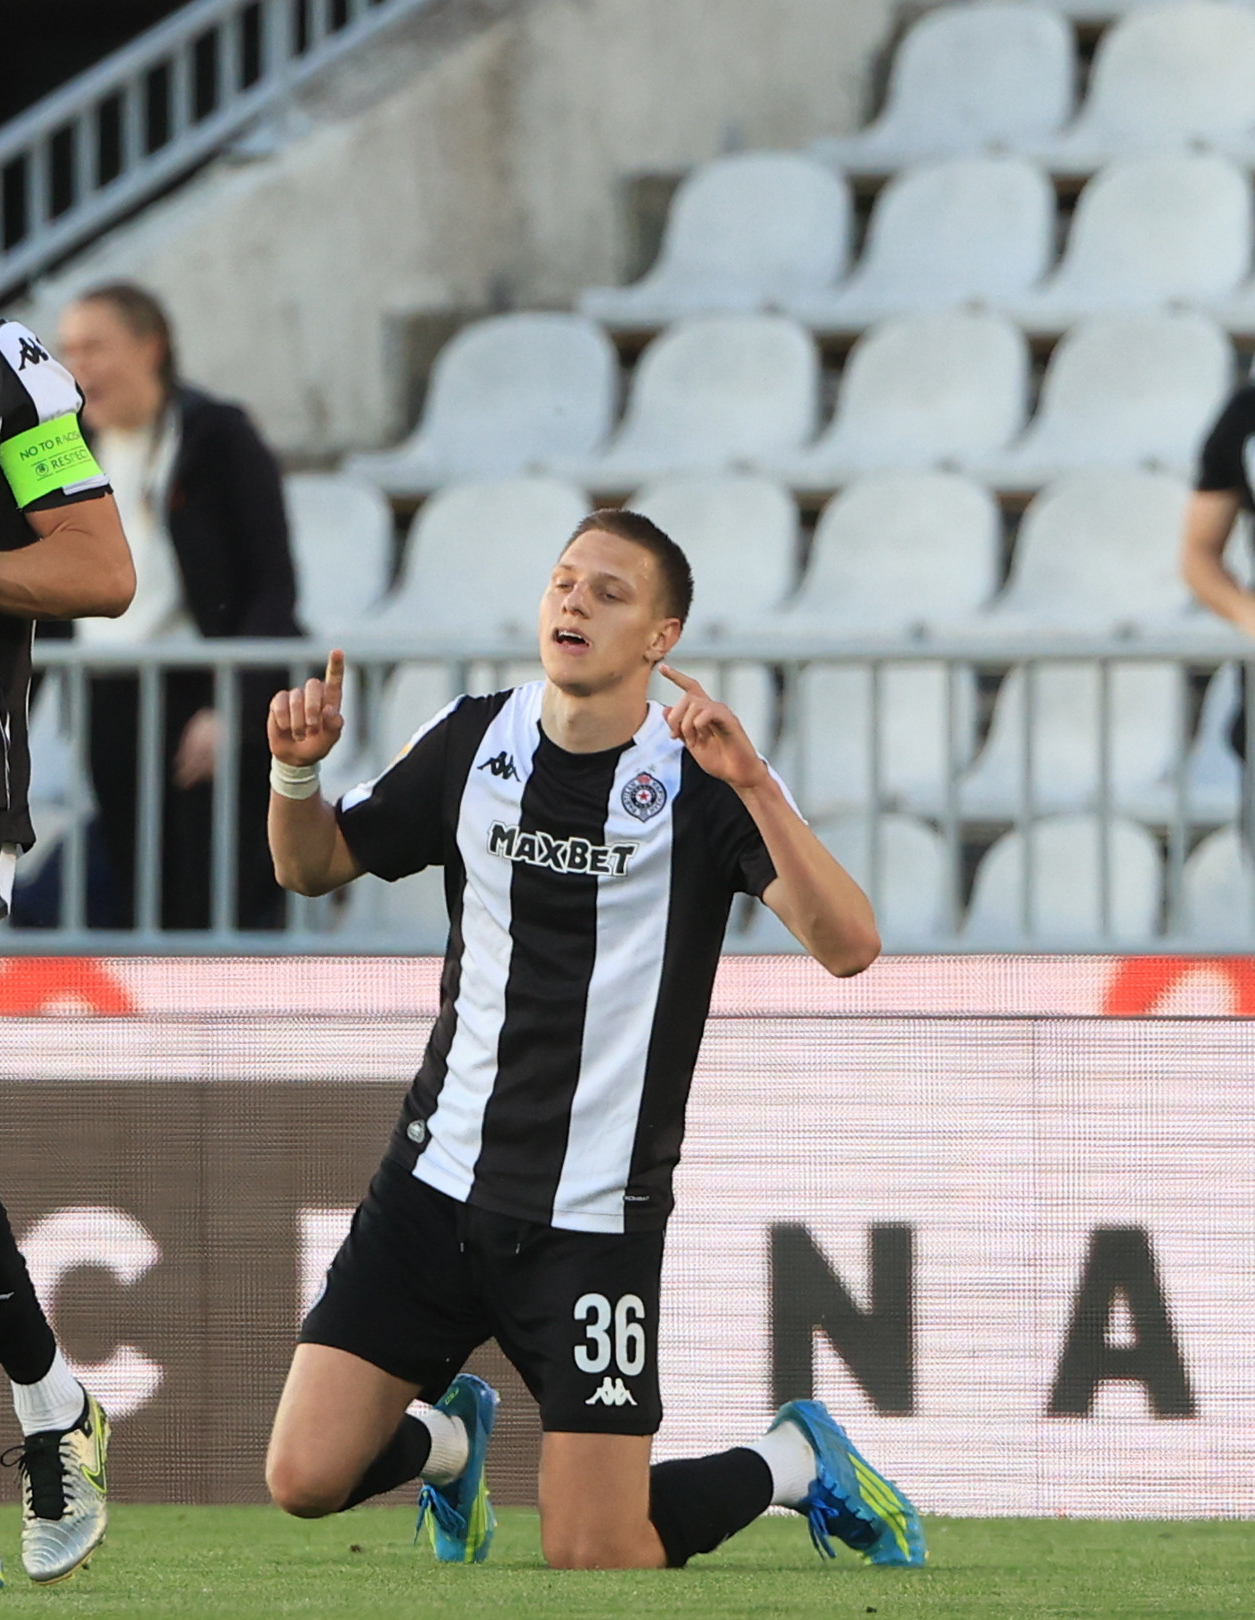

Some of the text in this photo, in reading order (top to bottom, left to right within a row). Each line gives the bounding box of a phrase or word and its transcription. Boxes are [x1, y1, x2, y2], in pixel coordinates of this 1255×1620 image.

[19, 446, 38, 461] NO
[39, 440, 54, 451] TO
[488, 820, 639, 877] MAXBET
[573, 1293, 647, 1377] 36
